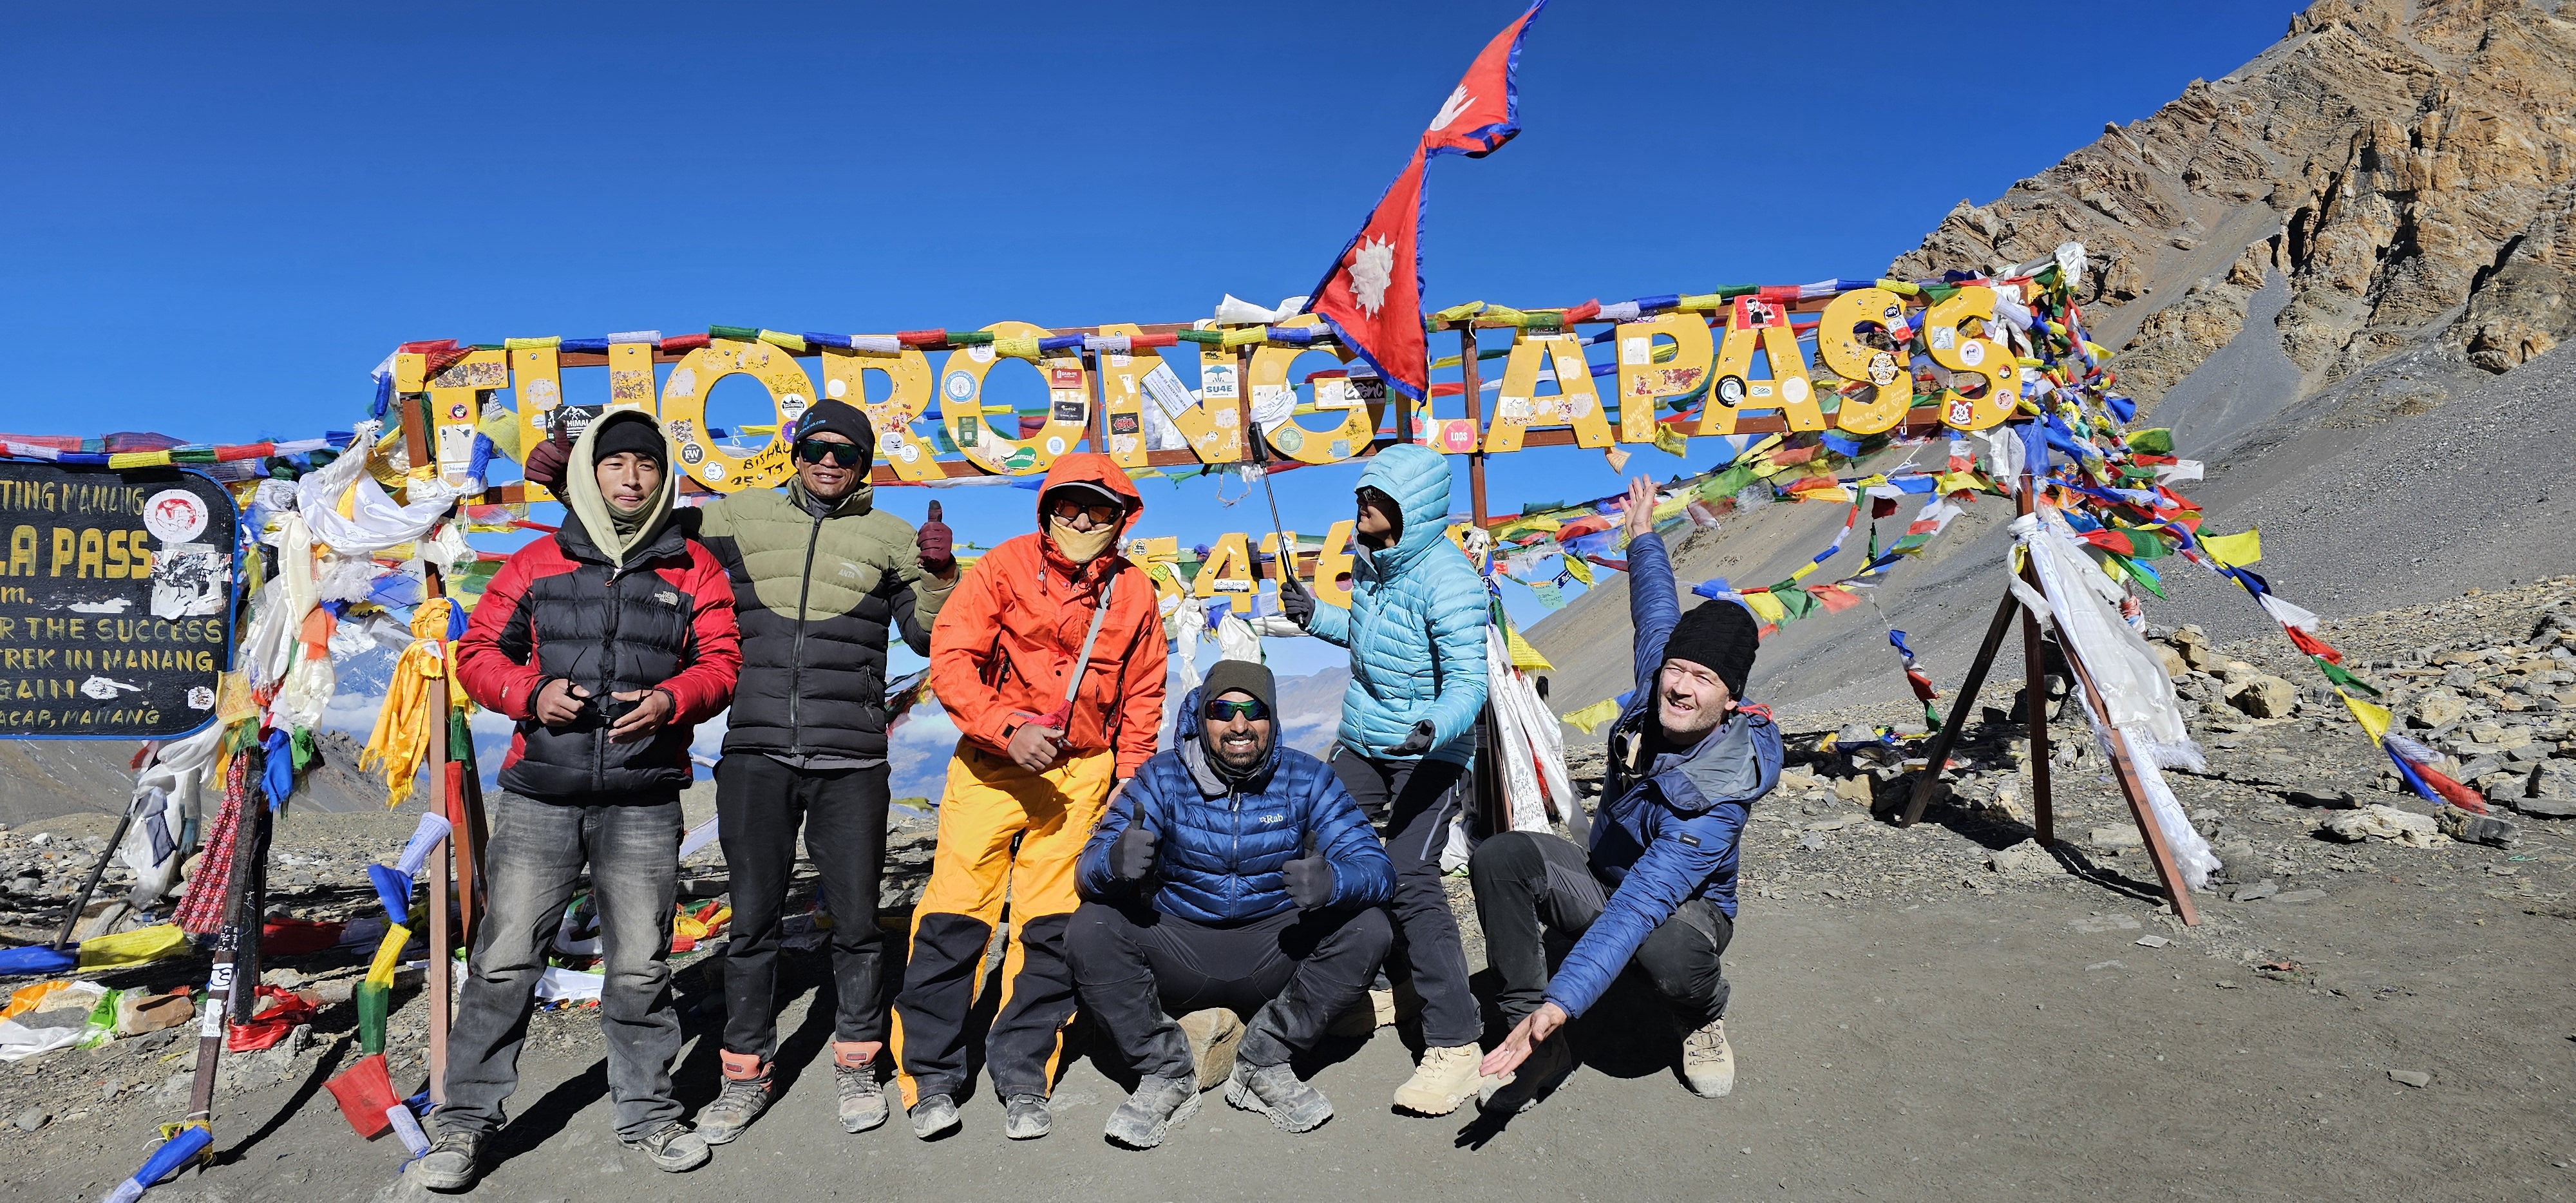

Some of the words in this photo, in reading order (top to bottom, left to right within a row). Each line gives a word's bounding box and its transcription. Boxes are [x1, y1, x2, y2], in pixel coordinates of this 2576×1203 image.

[395, 314, 1385, 502] THORONG
[1615, 286, 2022, 444] PASS
[0, 480, 54, 513] TING
[0, 525, 37, 577] A
[50, 527, 152, 580] PASS
[838, 569, 856, 579] ANTA
[24, 617, 85, 641] THE
[95, 618, 223, 643] SUCCESS
[0, 648, 55, 673] REK
[65, 649, 93, 671] IN
[102, 649, 214, 672] MANANG
[62, 709, 160, 727] MANANG
[1265, 813, 1283, 824] Rab
